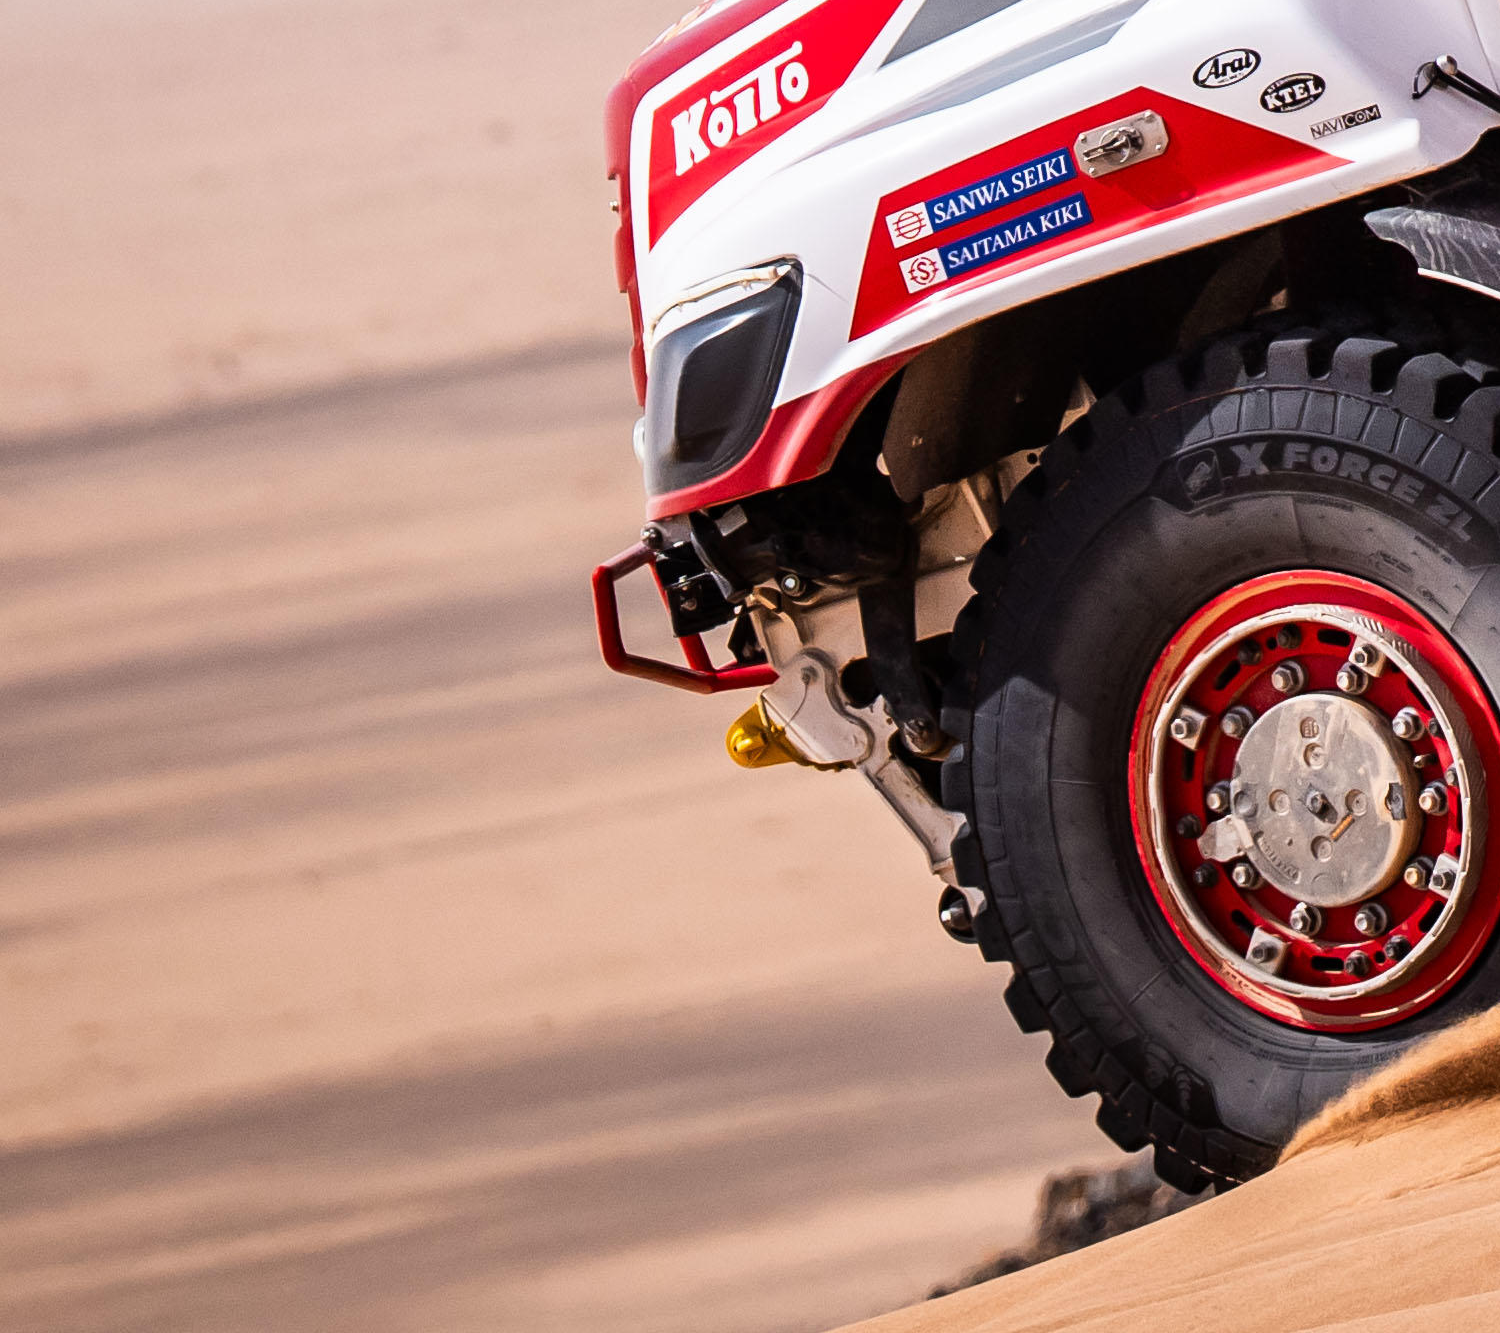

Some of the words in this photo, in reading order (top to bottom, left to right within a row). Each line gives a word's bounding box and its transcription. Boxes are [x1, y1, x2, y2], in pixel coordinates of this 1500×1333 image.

[1204, 51, 1253, 82] Arai
[1264, 80, 1322, 110] KTEL
[1311, 106, 1380, 139] NAVICOM
[933, 179, 1007, 224] SANWA
[1010, 155, 1069, 201] SEIKI
[948, 223, 1037, 270] SAITAMA
[1040, 200, 1084, 241] KIKI
[1231, 443, 1270, 475] X
[1282, 442, 1425, 502] FORCE
